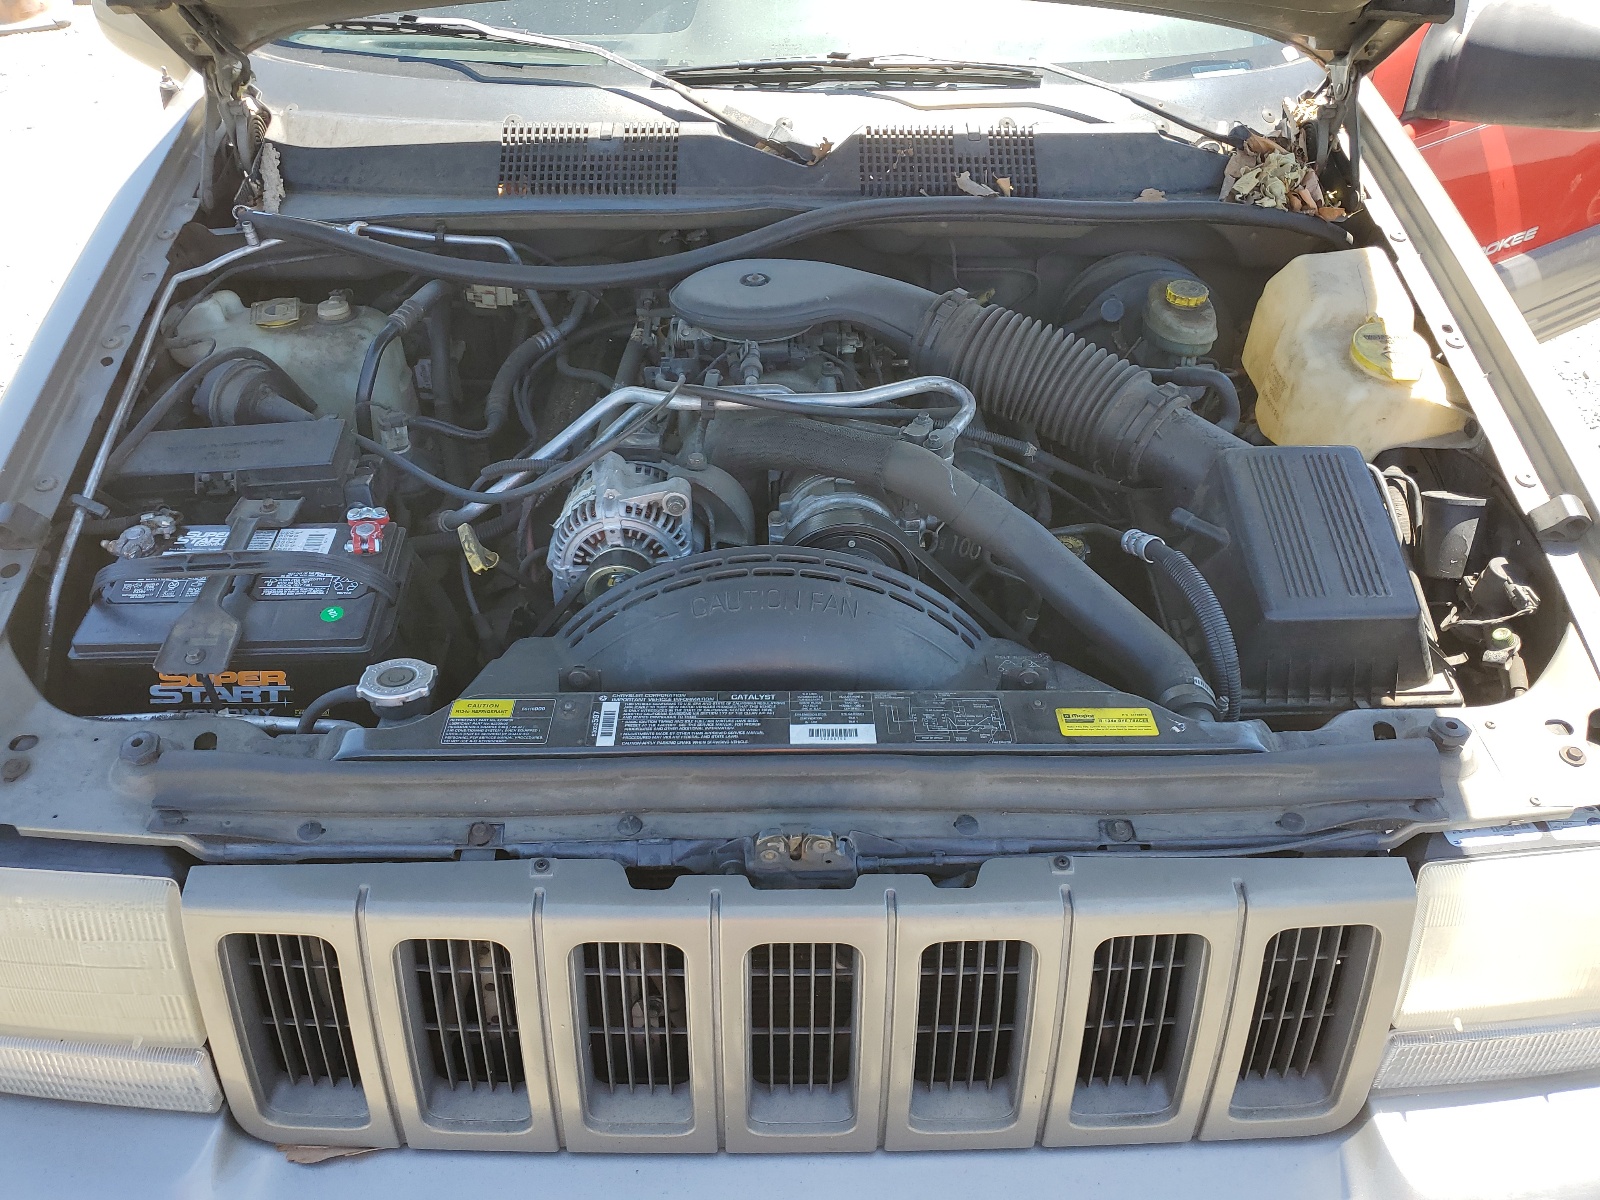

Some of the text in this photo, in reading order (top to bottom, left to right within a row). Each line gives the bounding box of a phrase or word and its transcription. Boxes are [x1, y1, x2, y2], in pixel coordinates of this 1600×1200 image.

[690, 589, 859, 619] CAUTION FAN
[149, 685, 291, 704] START
